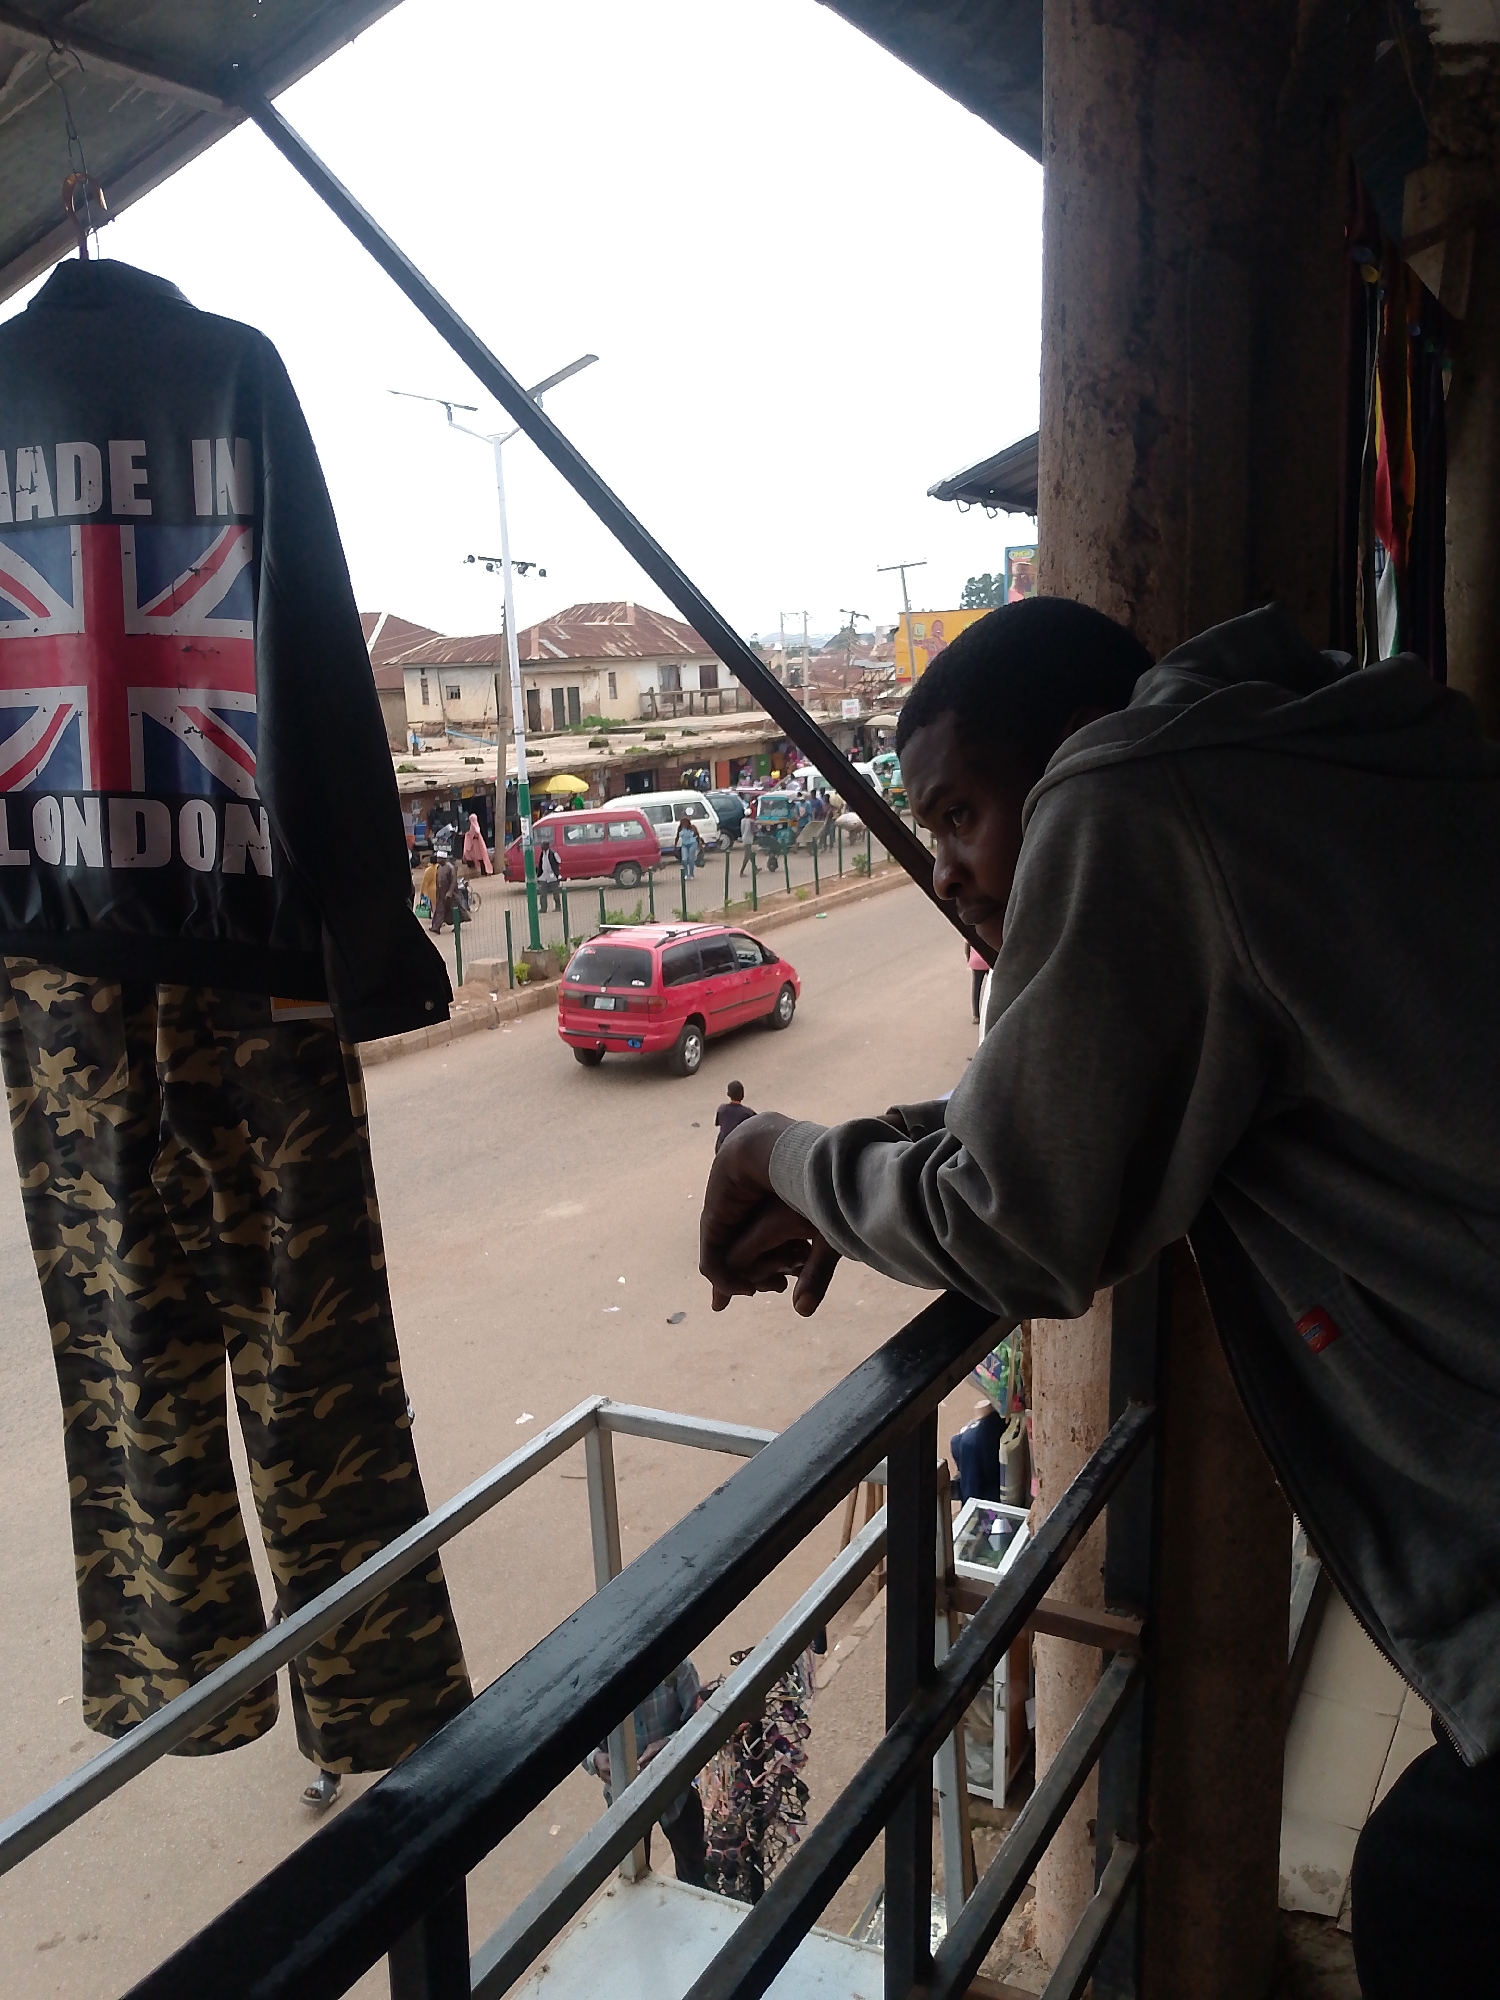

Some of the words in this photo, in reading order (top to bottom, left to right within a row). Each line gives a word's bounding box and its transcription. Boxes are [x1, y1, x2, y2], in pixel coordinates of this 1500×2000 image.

[0, 440, 152, 523] ADE
[191, 437, 254, 516] IN
[0, 795, 273, 878] LONDON
